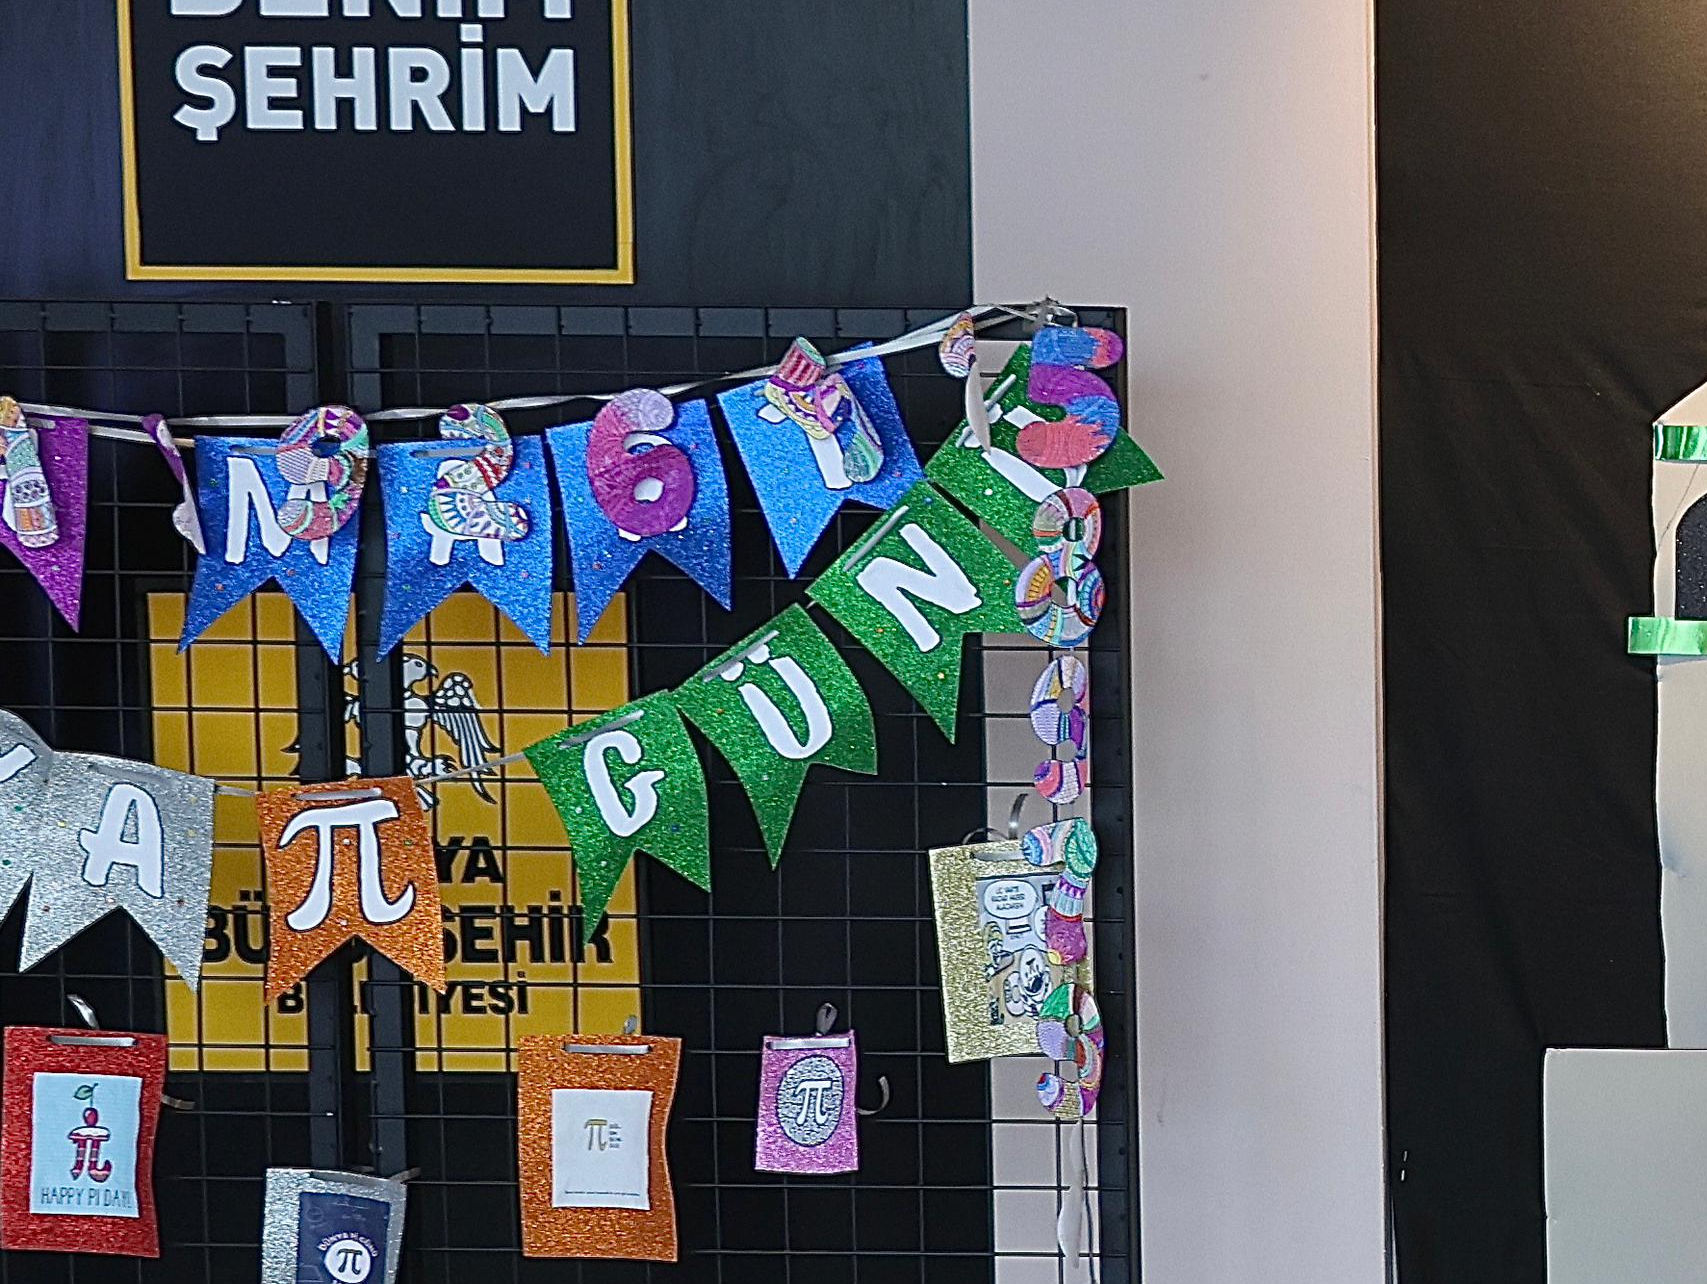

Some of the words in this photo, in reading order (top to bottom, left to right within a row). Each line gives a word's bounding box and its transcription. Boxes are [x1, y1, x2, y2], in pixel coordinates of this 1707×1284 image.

[173, 22, 577, 142] ŞEHRİM
[40, 1186, 84, 1206] HAPPY
[88, 1187, 100, 1206] PI
